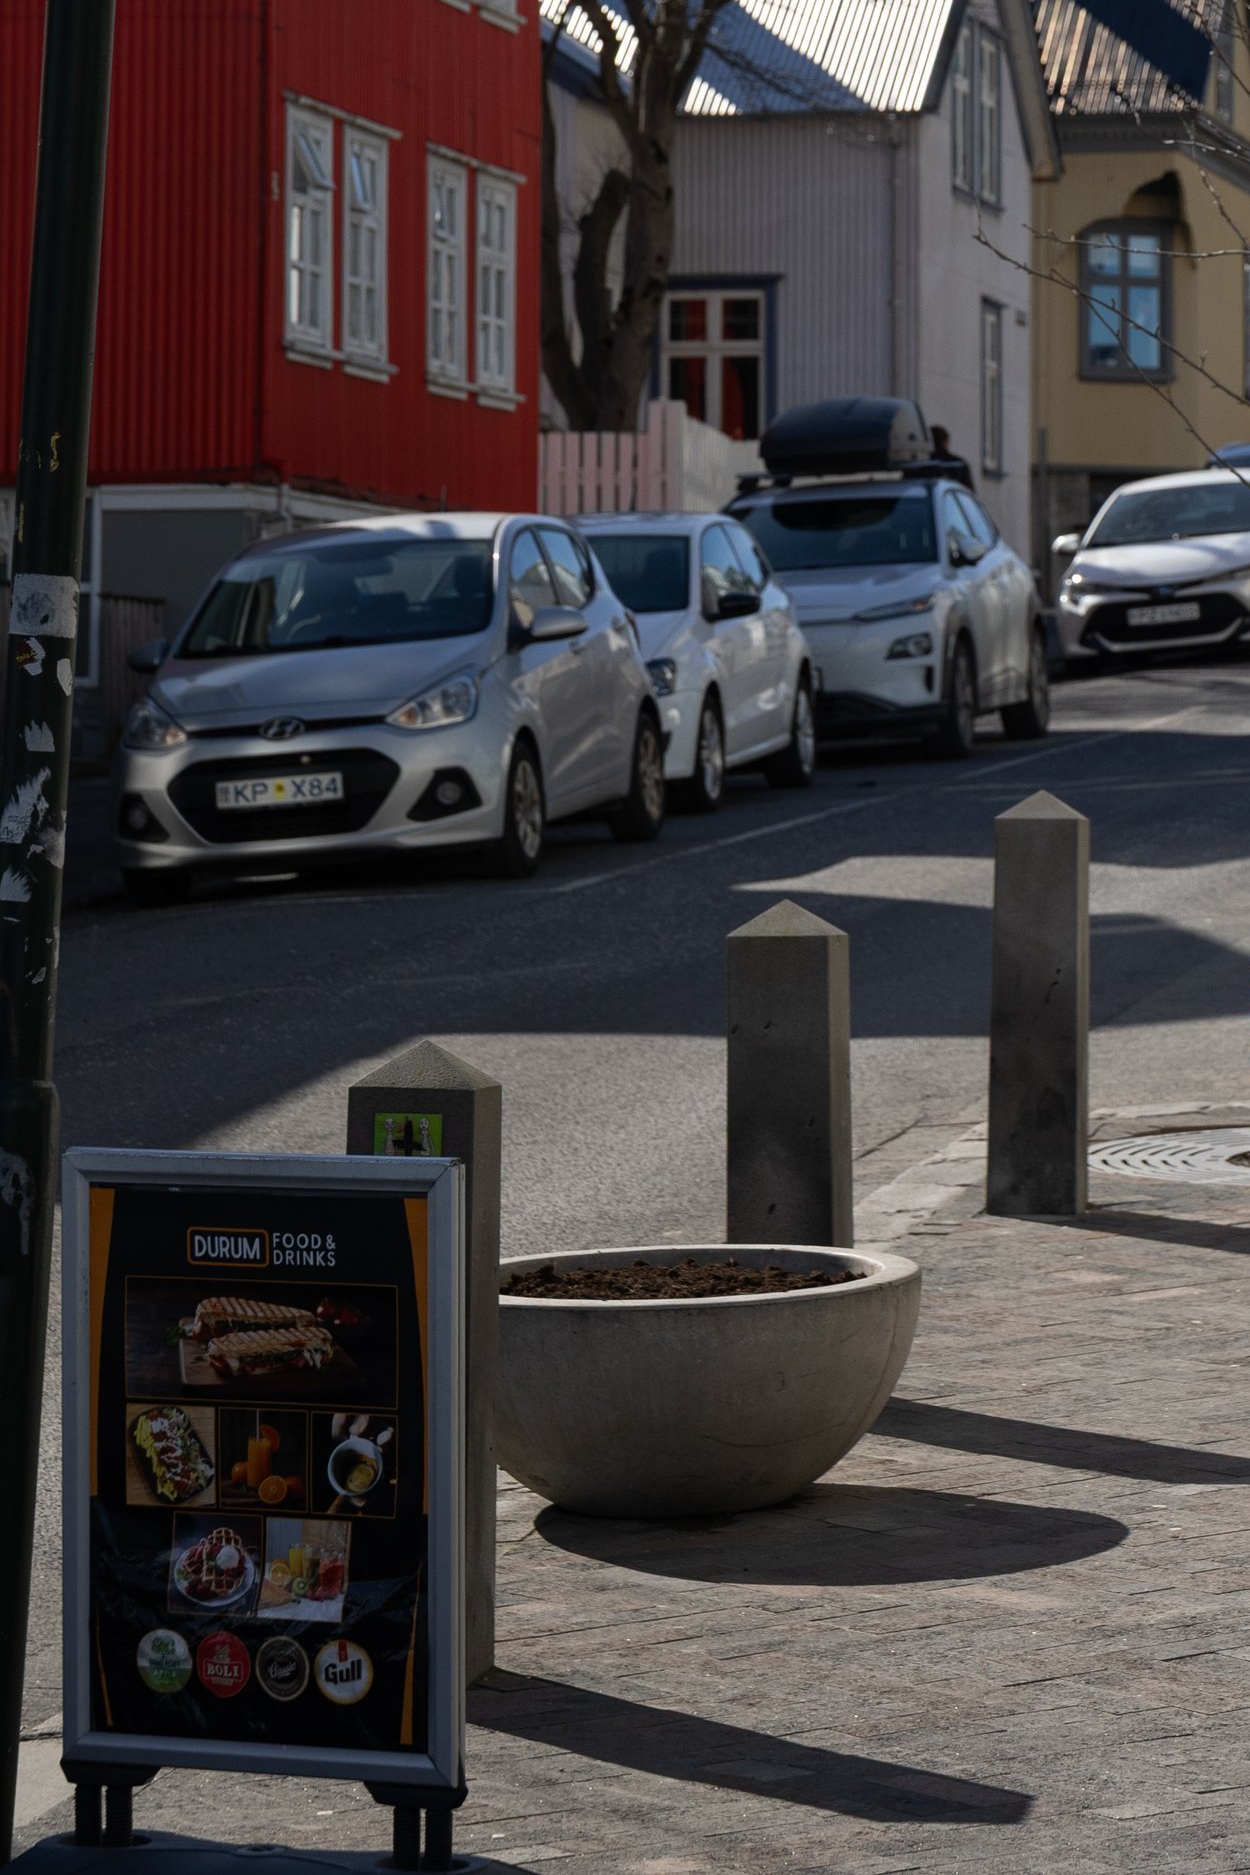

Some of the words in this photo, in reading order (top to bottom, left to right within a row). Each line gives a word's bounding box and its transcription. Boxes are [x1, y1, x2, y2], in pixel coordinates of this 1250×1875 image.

[233, 781, 268, 803] KP
[291, 777, 339, 799] X84
[193, 1234, 261, 1261] DURUM
[272, 1250, 336, 1267] DRINKS
[206, 1662, 240, 1678] BOLI
[324, 1657, 362, 1684] Gull
